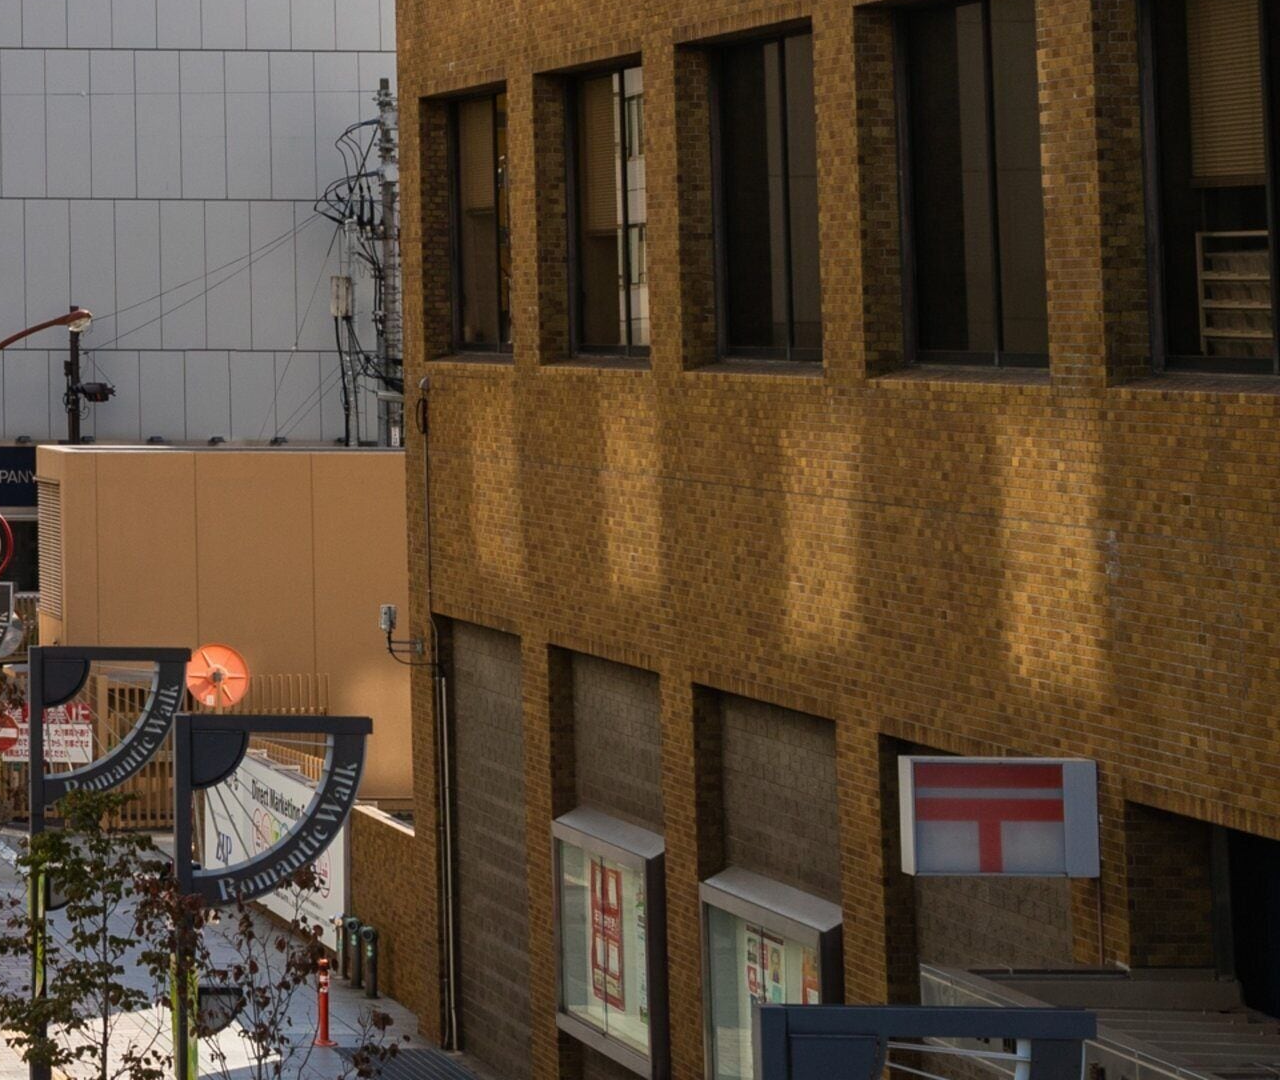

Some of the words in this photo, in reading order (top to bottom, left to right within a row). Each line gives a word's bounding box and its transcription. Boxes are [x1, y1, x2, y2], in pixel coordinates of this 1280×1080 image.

[149, 680, 180, 739] Walk
[251, 779, 269, 806] Direct
[216, 824, 329, 901] Romantic
[314, 761, 358, 823] Walk
